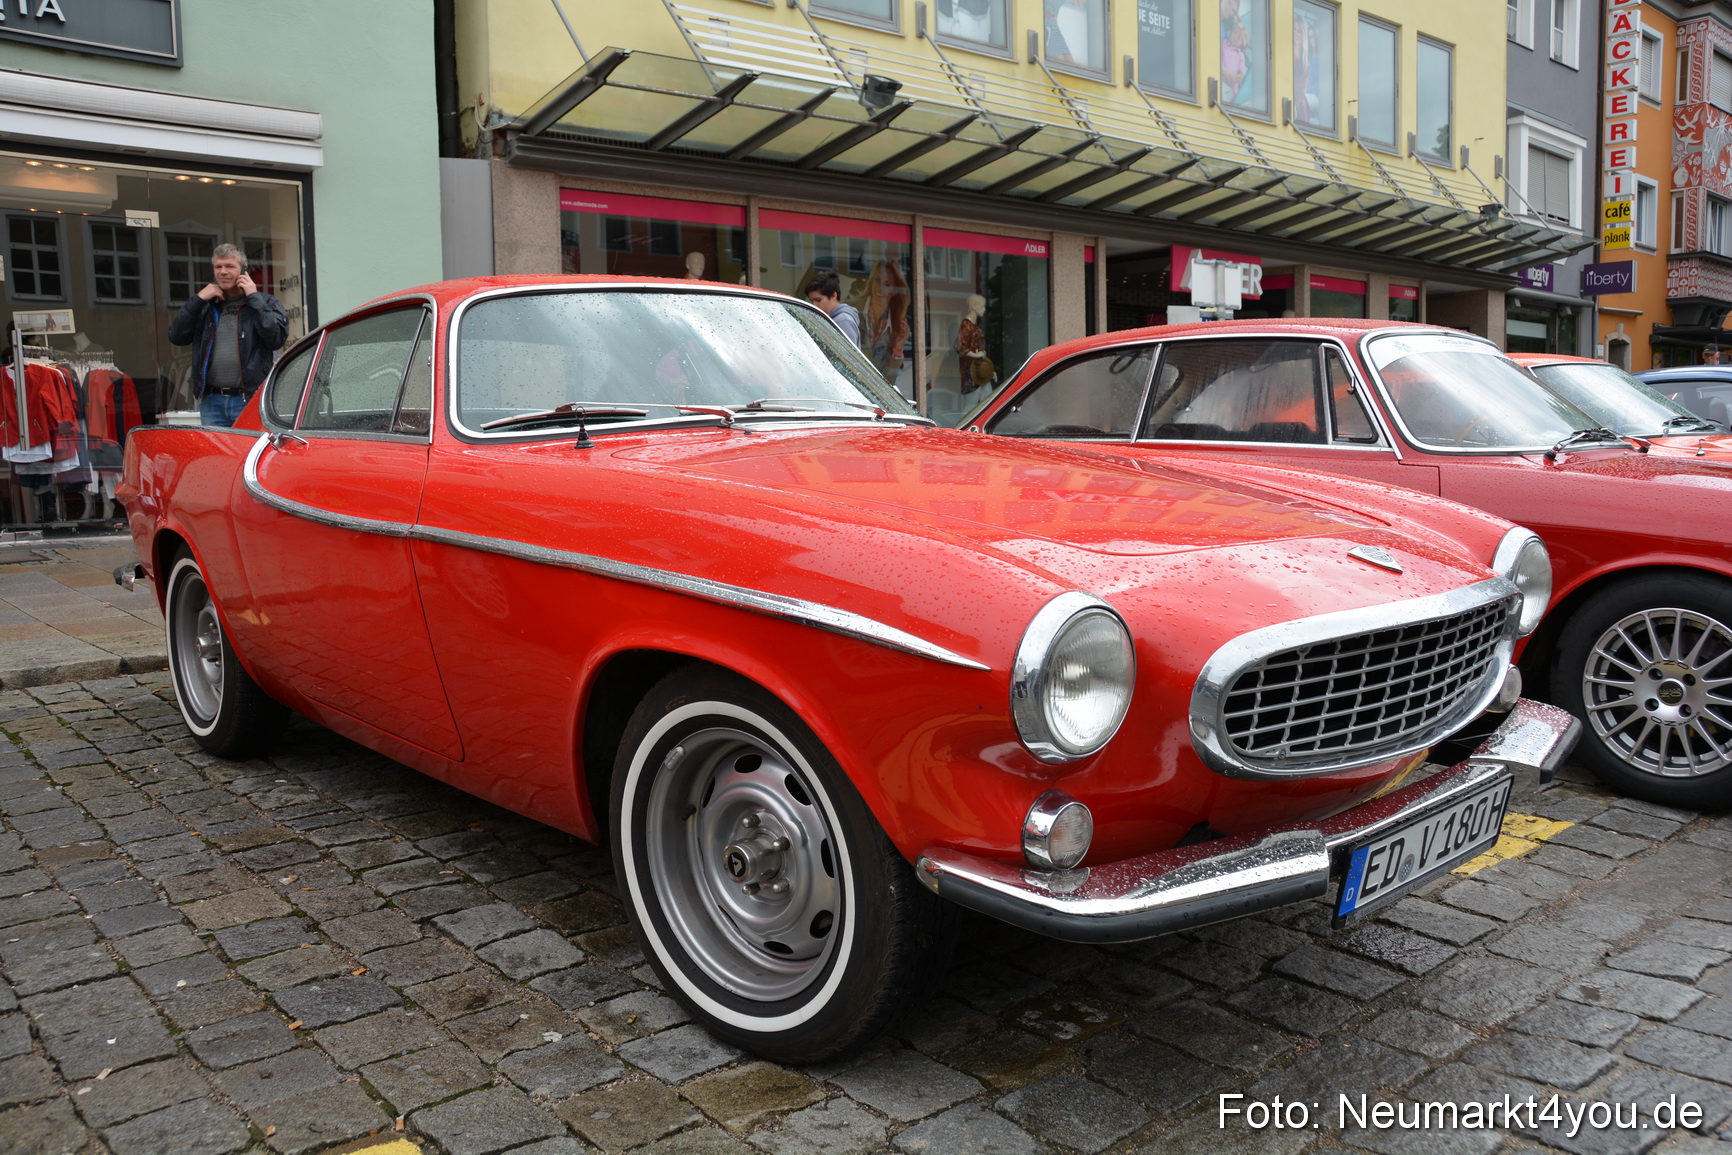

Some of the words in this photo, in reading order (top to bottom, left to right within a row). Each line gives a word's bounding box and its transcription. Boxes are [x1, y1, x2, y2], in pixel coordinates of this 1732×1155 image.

[1148, 11, 1171, 30] SEITE
[1605, 203, 1631, 218] café
[1604, 231, 1630, 247] plank
[1024, 243, 1046, 254] ADLER
[1528, 267, 1549, 286] liberty
[1586, 270, 1630, 287] liberty
[1360, 837, 1406, 899] ED
[1346, 887, 1354, 902] D
